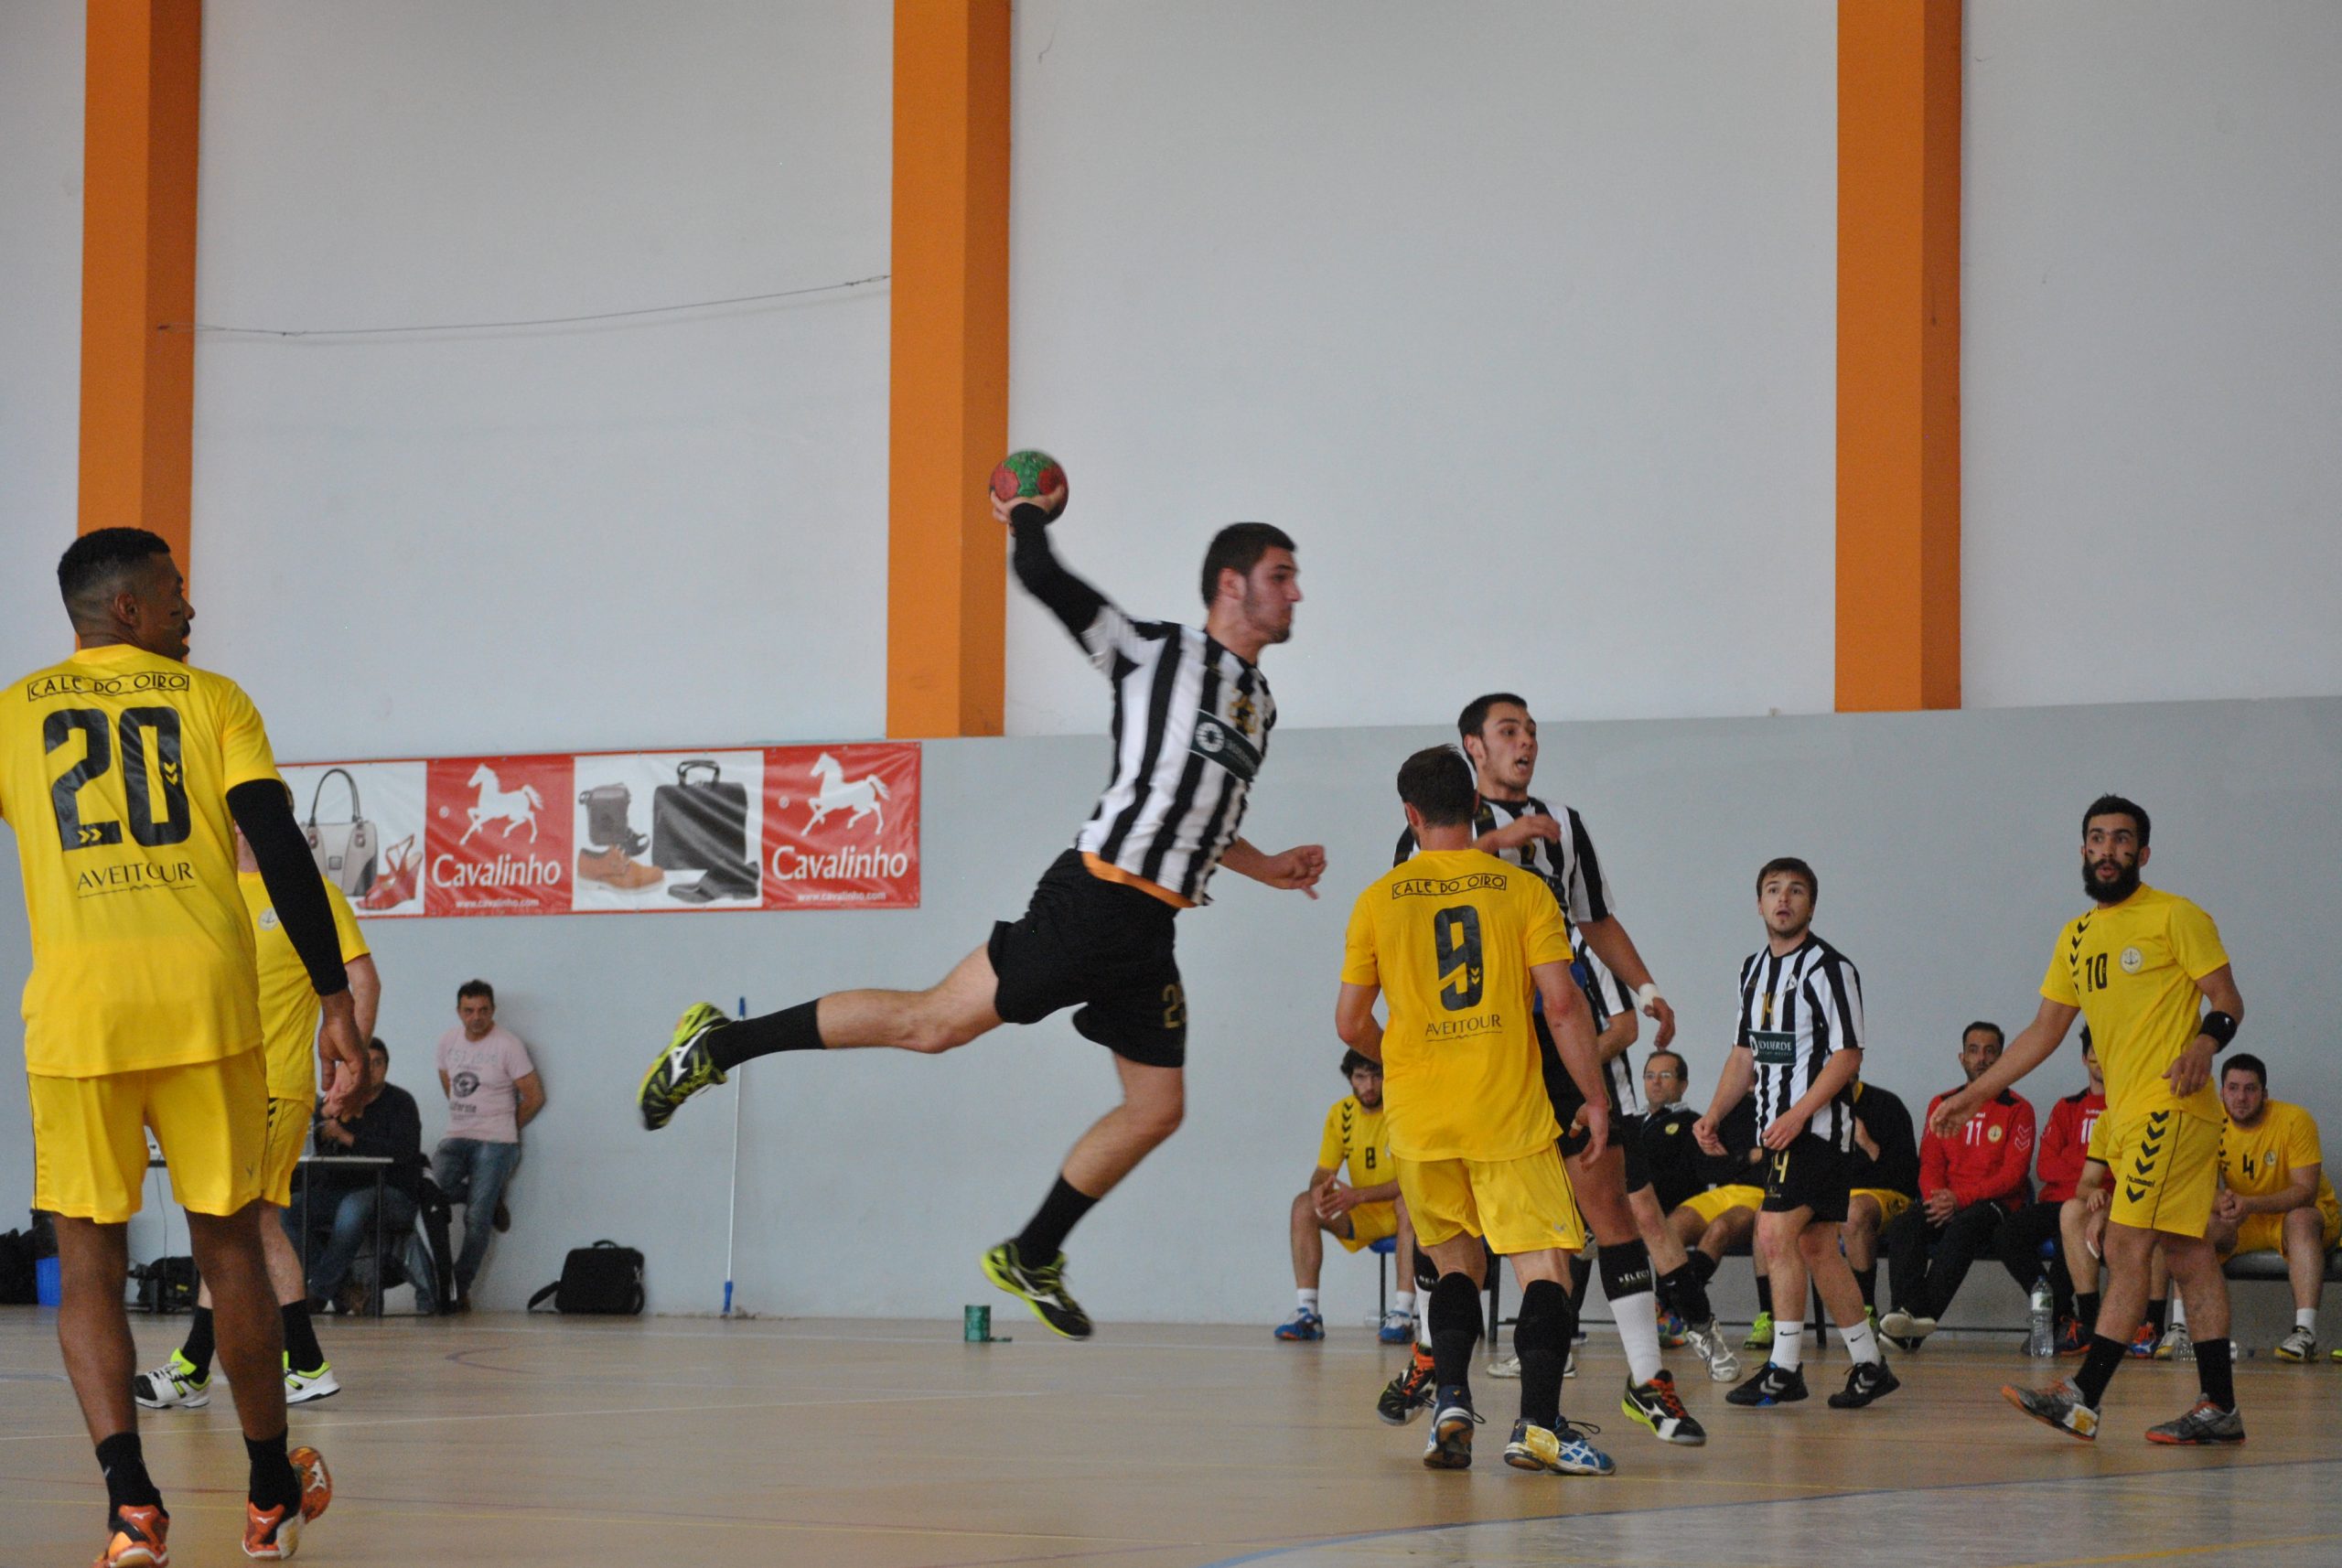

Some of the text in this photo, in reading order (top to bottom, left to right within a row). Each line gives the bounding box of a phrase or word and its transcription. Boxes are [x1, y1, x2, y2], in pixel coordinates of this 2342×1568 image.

[32, 672, 187, 697] CALE DO OIRO
[43, 706, 191, 852] 20
[77, 862, 195, 892] AVEITOUR
[432, 853, 562, 888] Cavalinho
[772, 845, 908, 881] Cavalinho
[1393, 874, 1506, 896] CALE DO OIRO
[1434, 905, 1484, 1012] 9
[2085, 952, 2109, 993] 10
[1162, 983, 1187, 1029] 2
[1760, 992, 1778, 1026] 14
[1425, 1015, 1502, 1037] AVEITOUR
[1966, 1119, 1982, 1146] 11
[1365, 1146, 1376, 1170] 8
[2242, 1153, 2254, 1180] 4
